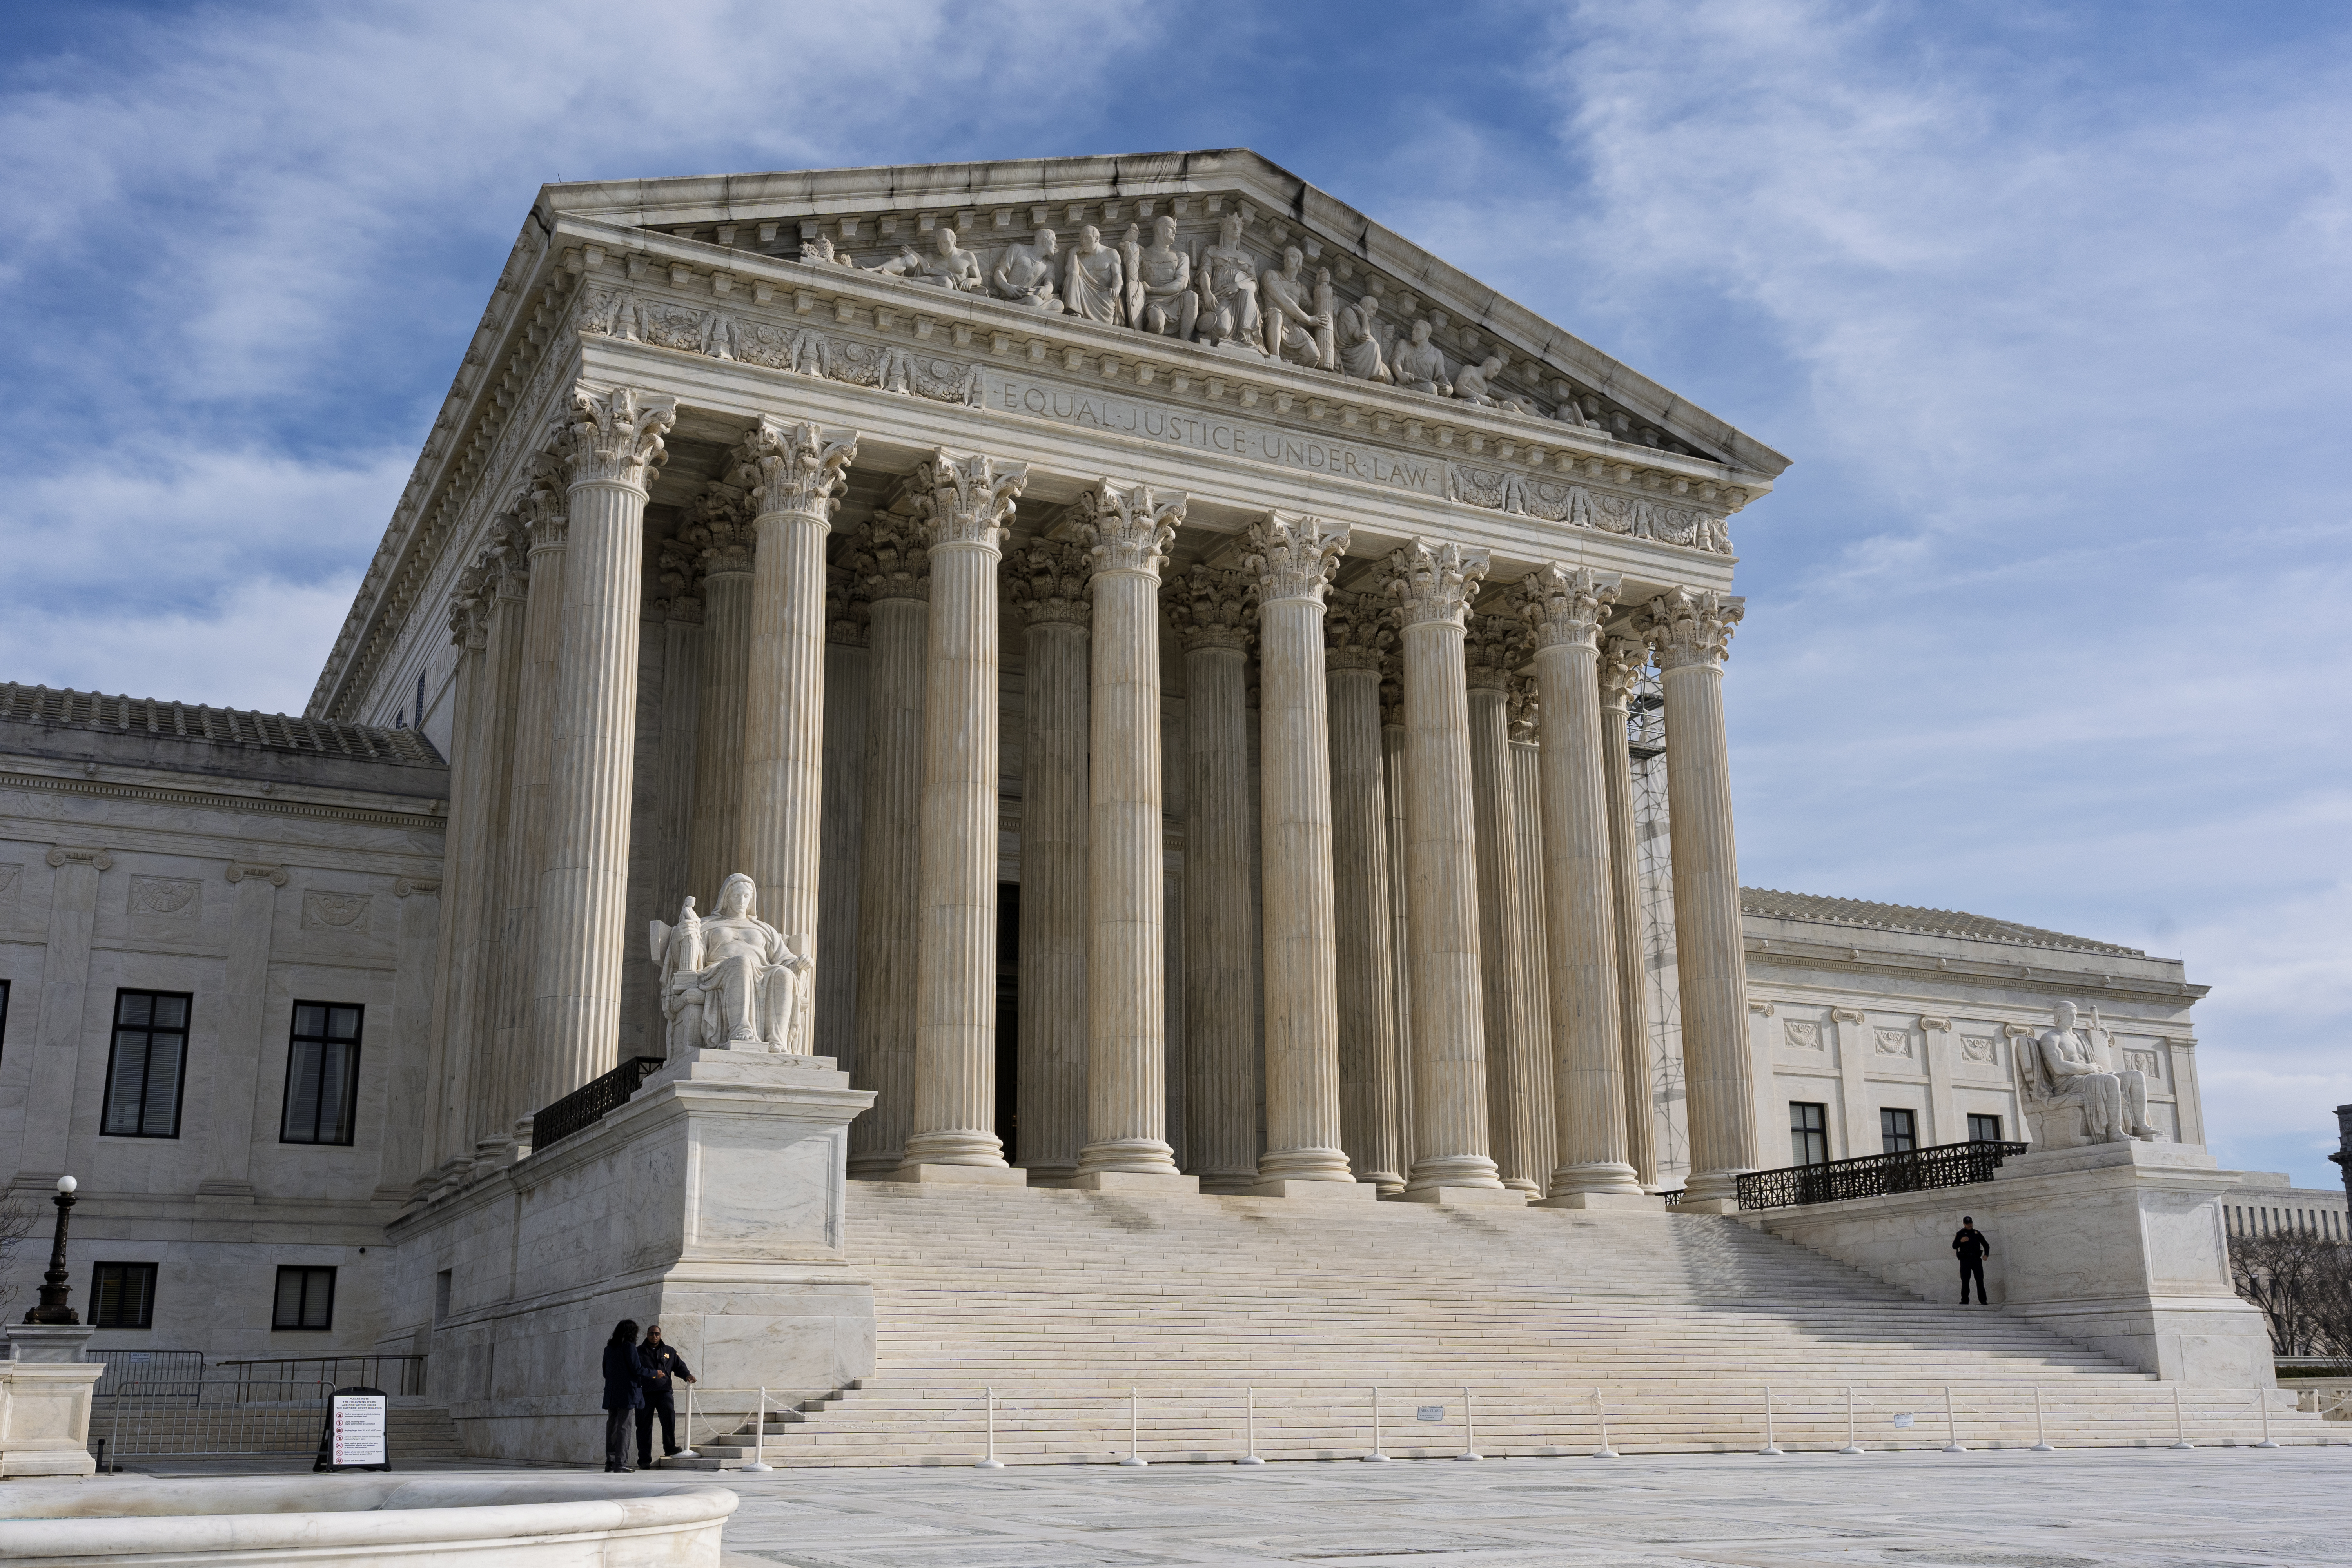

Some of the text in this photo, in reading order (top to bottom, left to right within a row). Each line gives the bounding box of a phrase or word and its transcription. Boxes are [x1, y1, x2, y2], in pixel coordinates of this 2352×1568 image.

[1004, 383, 1429, 488] EQUAL JUSTICE UNDER LAW
